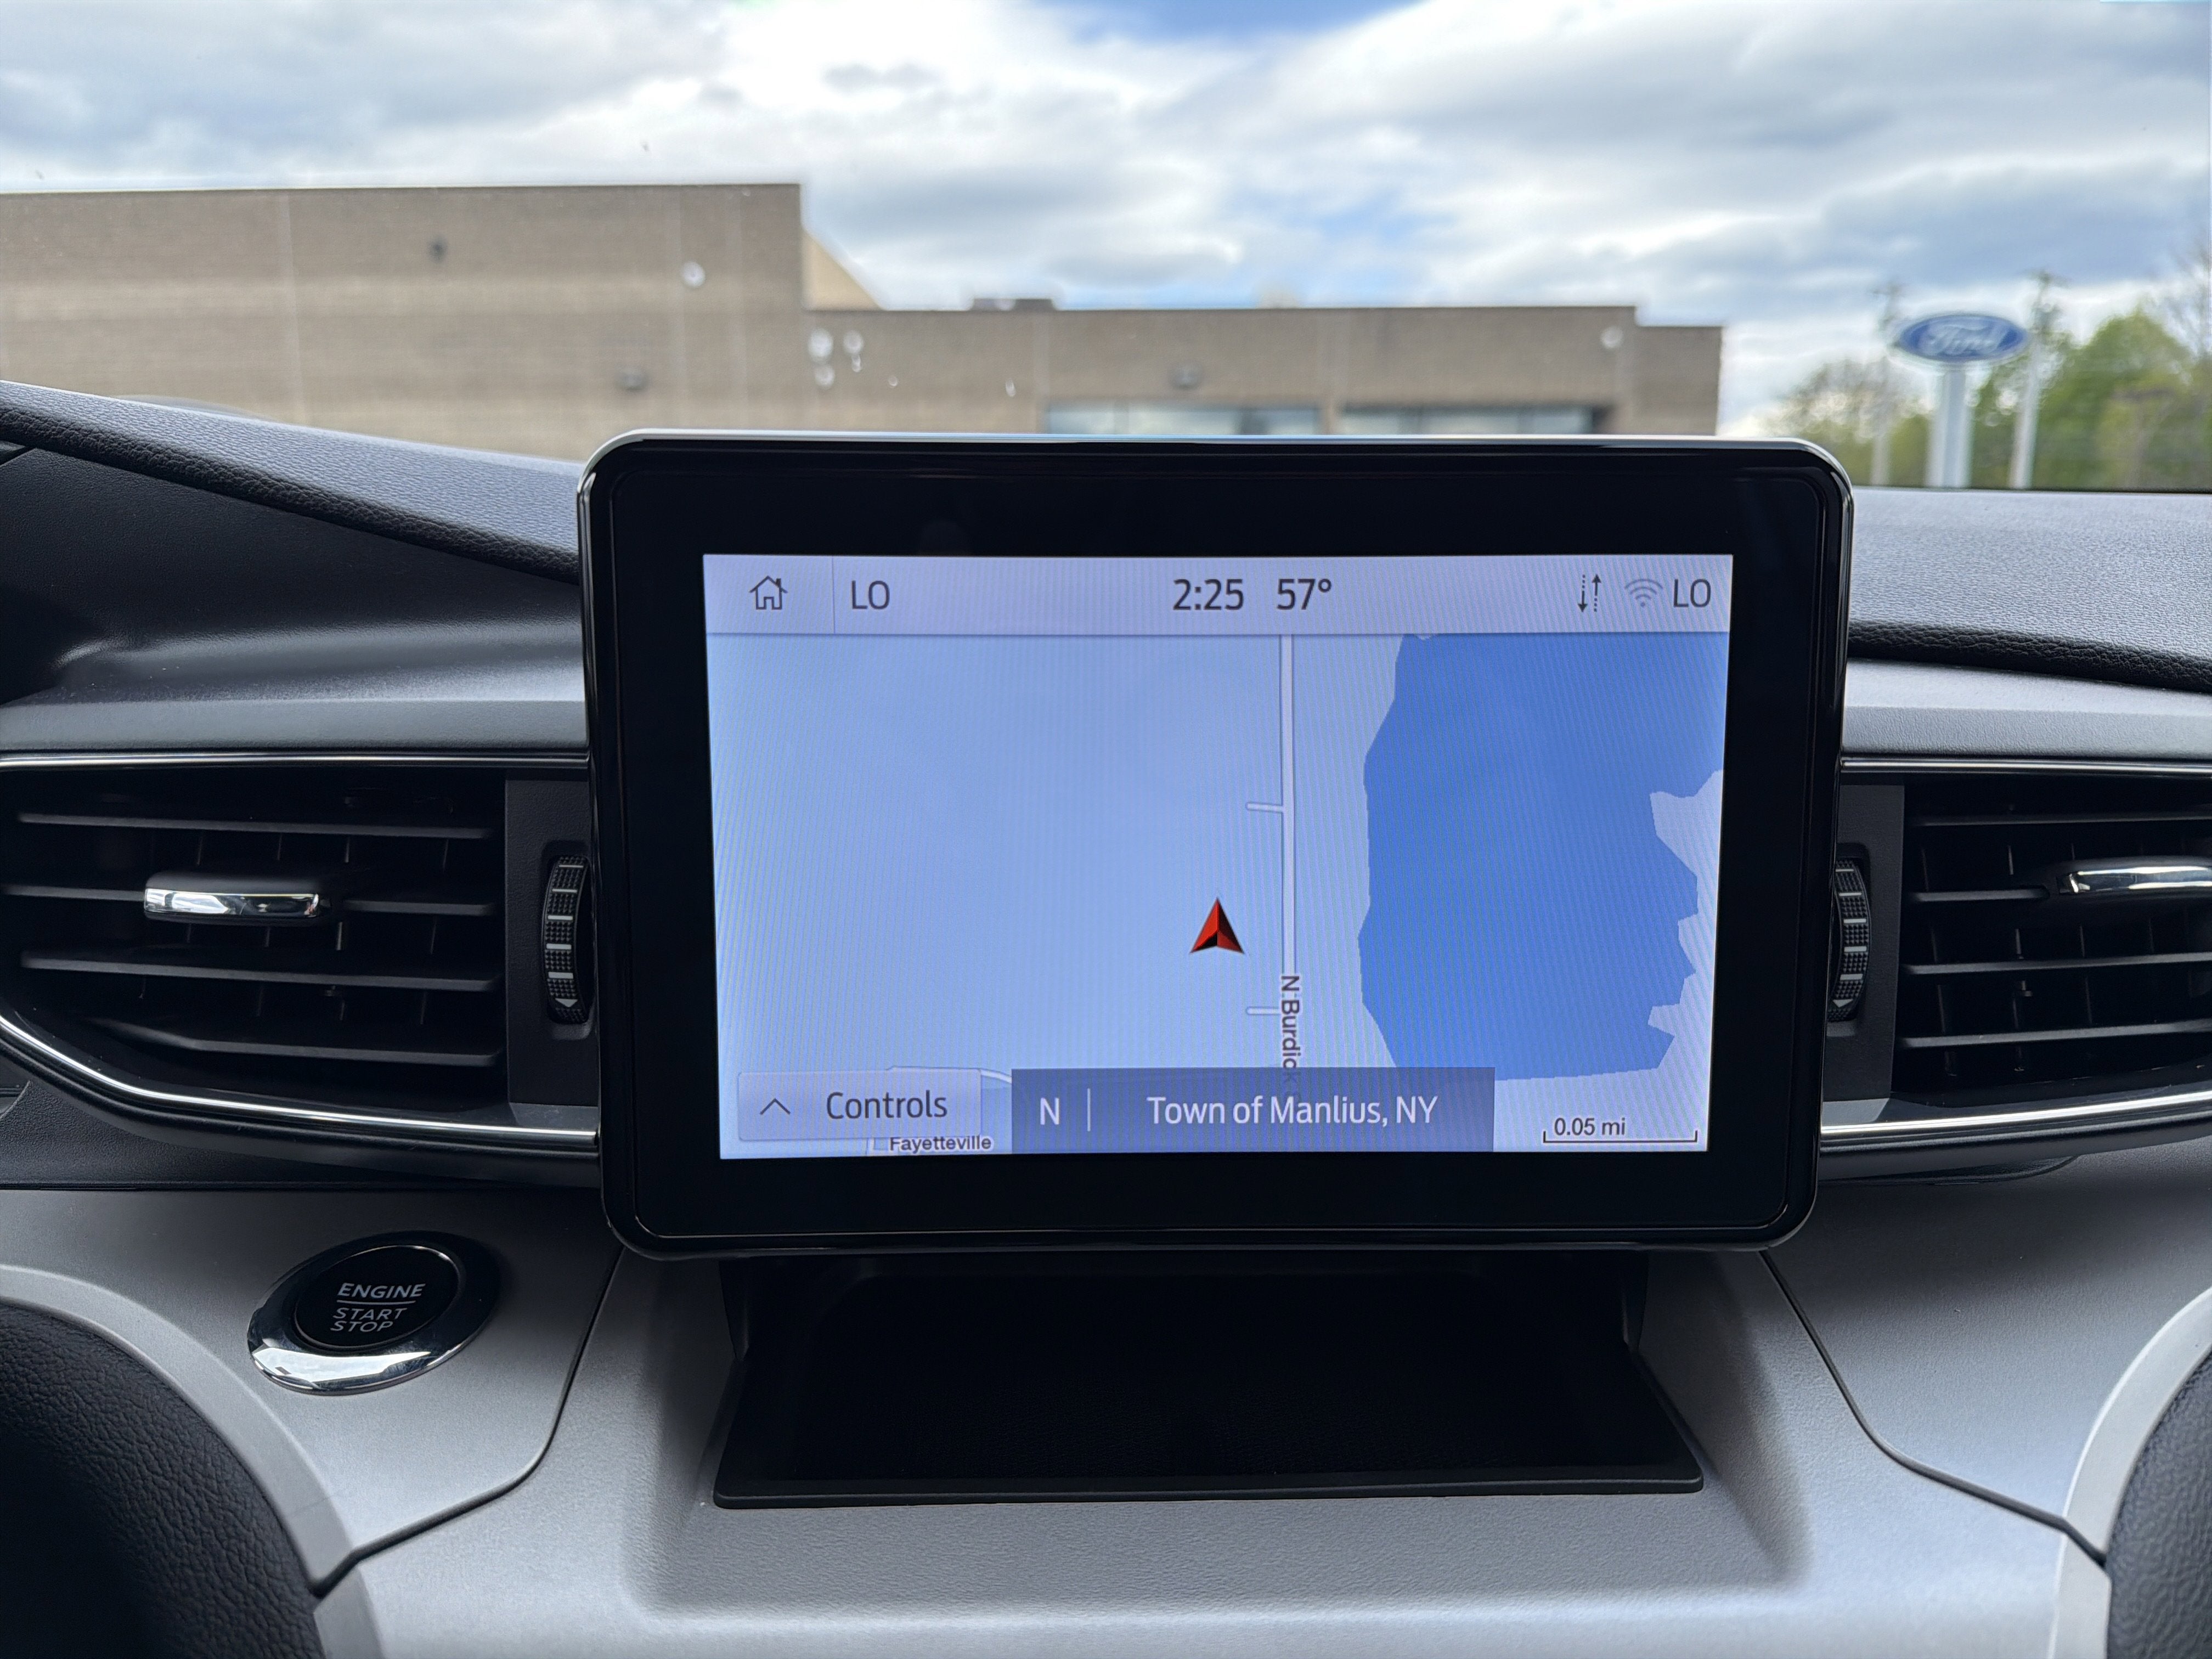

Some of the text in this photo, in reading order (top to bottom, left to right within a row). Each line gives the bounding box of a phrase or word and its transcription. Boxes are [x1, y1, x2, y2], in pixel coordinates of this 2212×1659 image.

[851, 580, 890, 610] LO
[1173, 579, 1244, 610] 2:25
[1277, 578, 1332, 610] 57°
[1673, 578, 1711, 608] LO
[1281, 975, 1300, 991] N
[826, 1090, 948, 1119] Controls
[1040, 1097, 1059, 1125] N
[1146, 1096, 1225, 1124] Town
[1233, 1095, 1263, 1124] of
[1271, 1095, 1388, 1127] Manlius,
[1396, 1096, 1438, 1124] NY
[1554, 1116, 1626, 1136] 0.05 mi
[889, 1135, 992, 1154] Fayetteville
[337, 1282, 426, 1299] ENGINE
[329, 1320, 393, 1333] STOP
[332, 1307, 408, 1321] START
